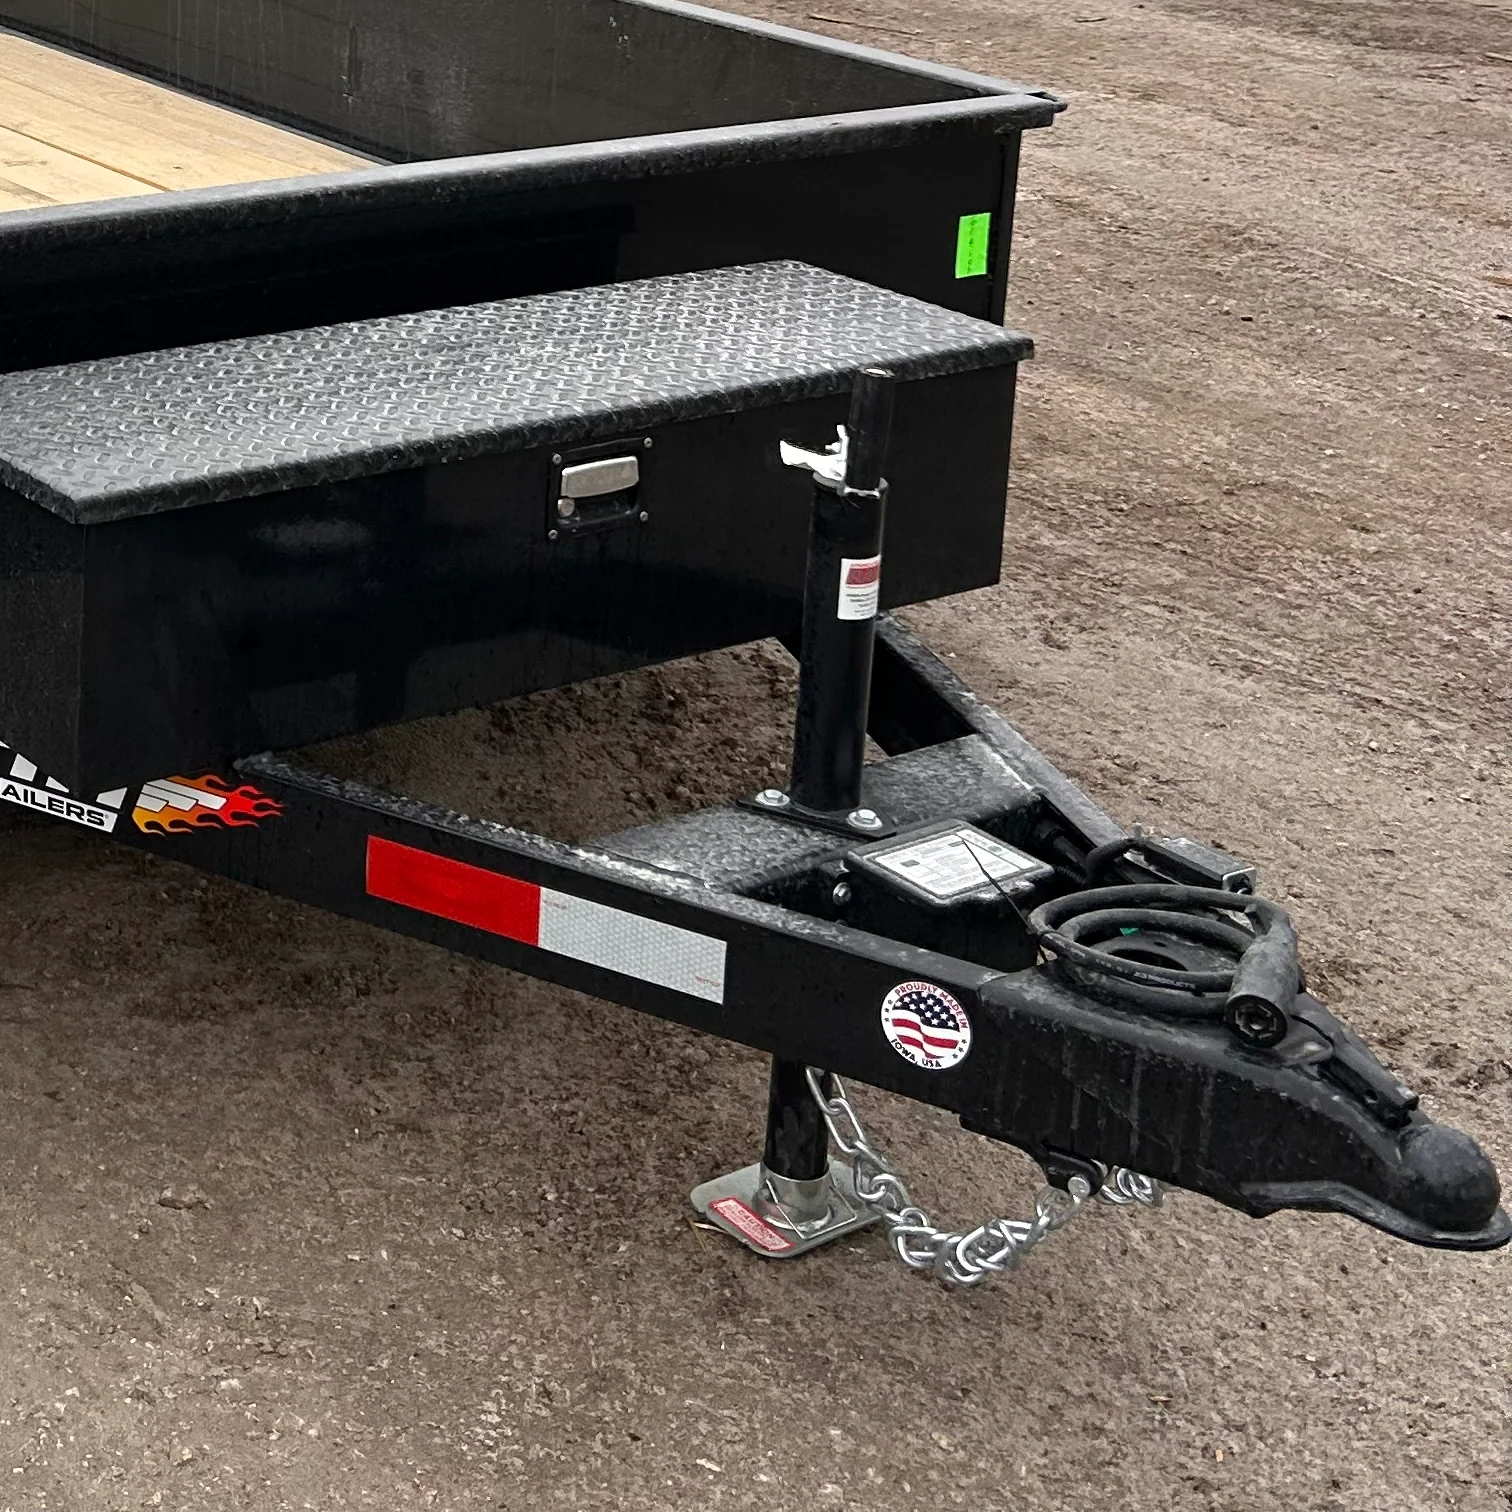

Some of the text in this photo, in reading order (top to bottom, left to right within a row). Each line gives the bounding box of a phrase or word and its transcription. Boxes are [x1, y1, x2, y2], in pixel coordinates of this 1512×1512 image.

[894, 982, 969, 1029] PROUDLY MADE IN
[891, 1038, 942, 1068] IOWA, USA
